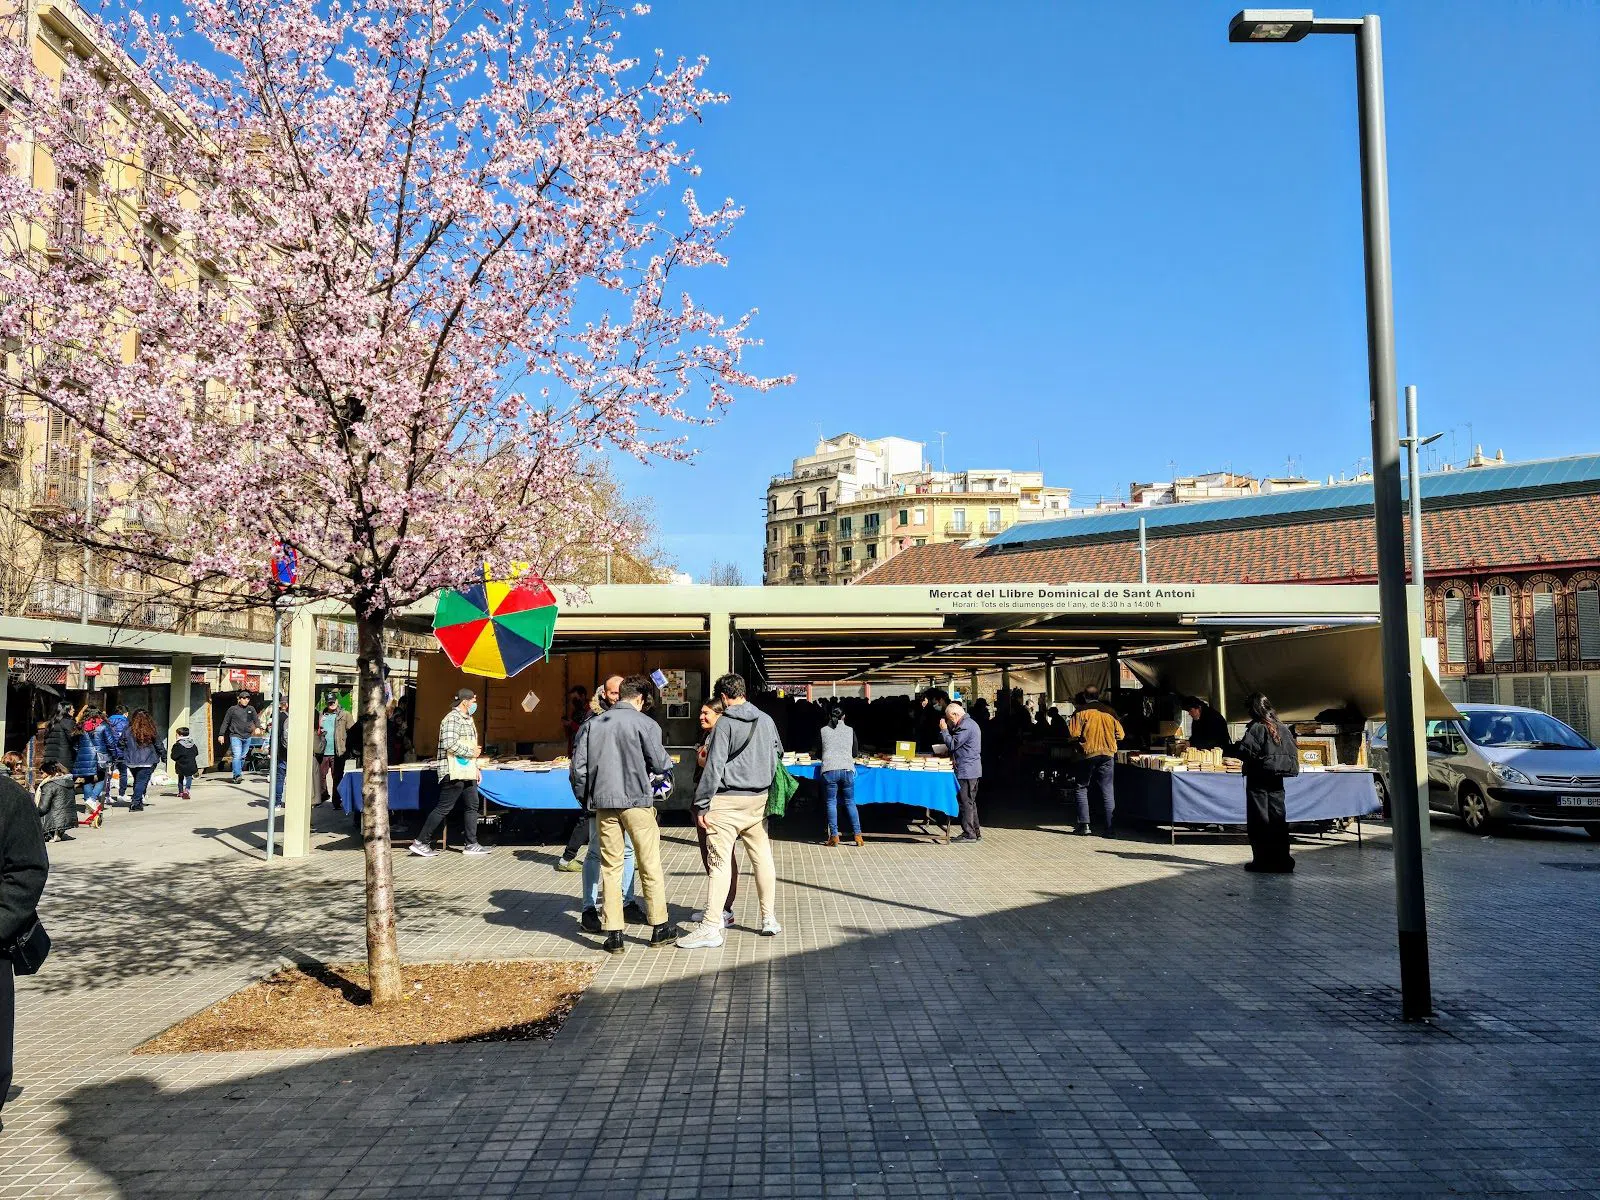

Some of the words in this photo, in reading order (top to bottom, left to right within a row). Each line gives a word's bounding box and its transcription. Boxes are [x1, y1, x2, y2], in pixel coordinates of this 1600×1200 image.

[929, 589, 973, 598] Mercat
[976, 589, 995, 598] del
[999, 589, 1034, 598] Llibre
[1038, 589, 1100, 598] Dominical
[1103, 589, 1119, 598] de
[1122, 589, 1152, 598] Sant
[1155, 589, 1195, 598] Antoni
[1012, 601, 1054, 610] diumenges
[1561, 797, 1582, 806] 5510
